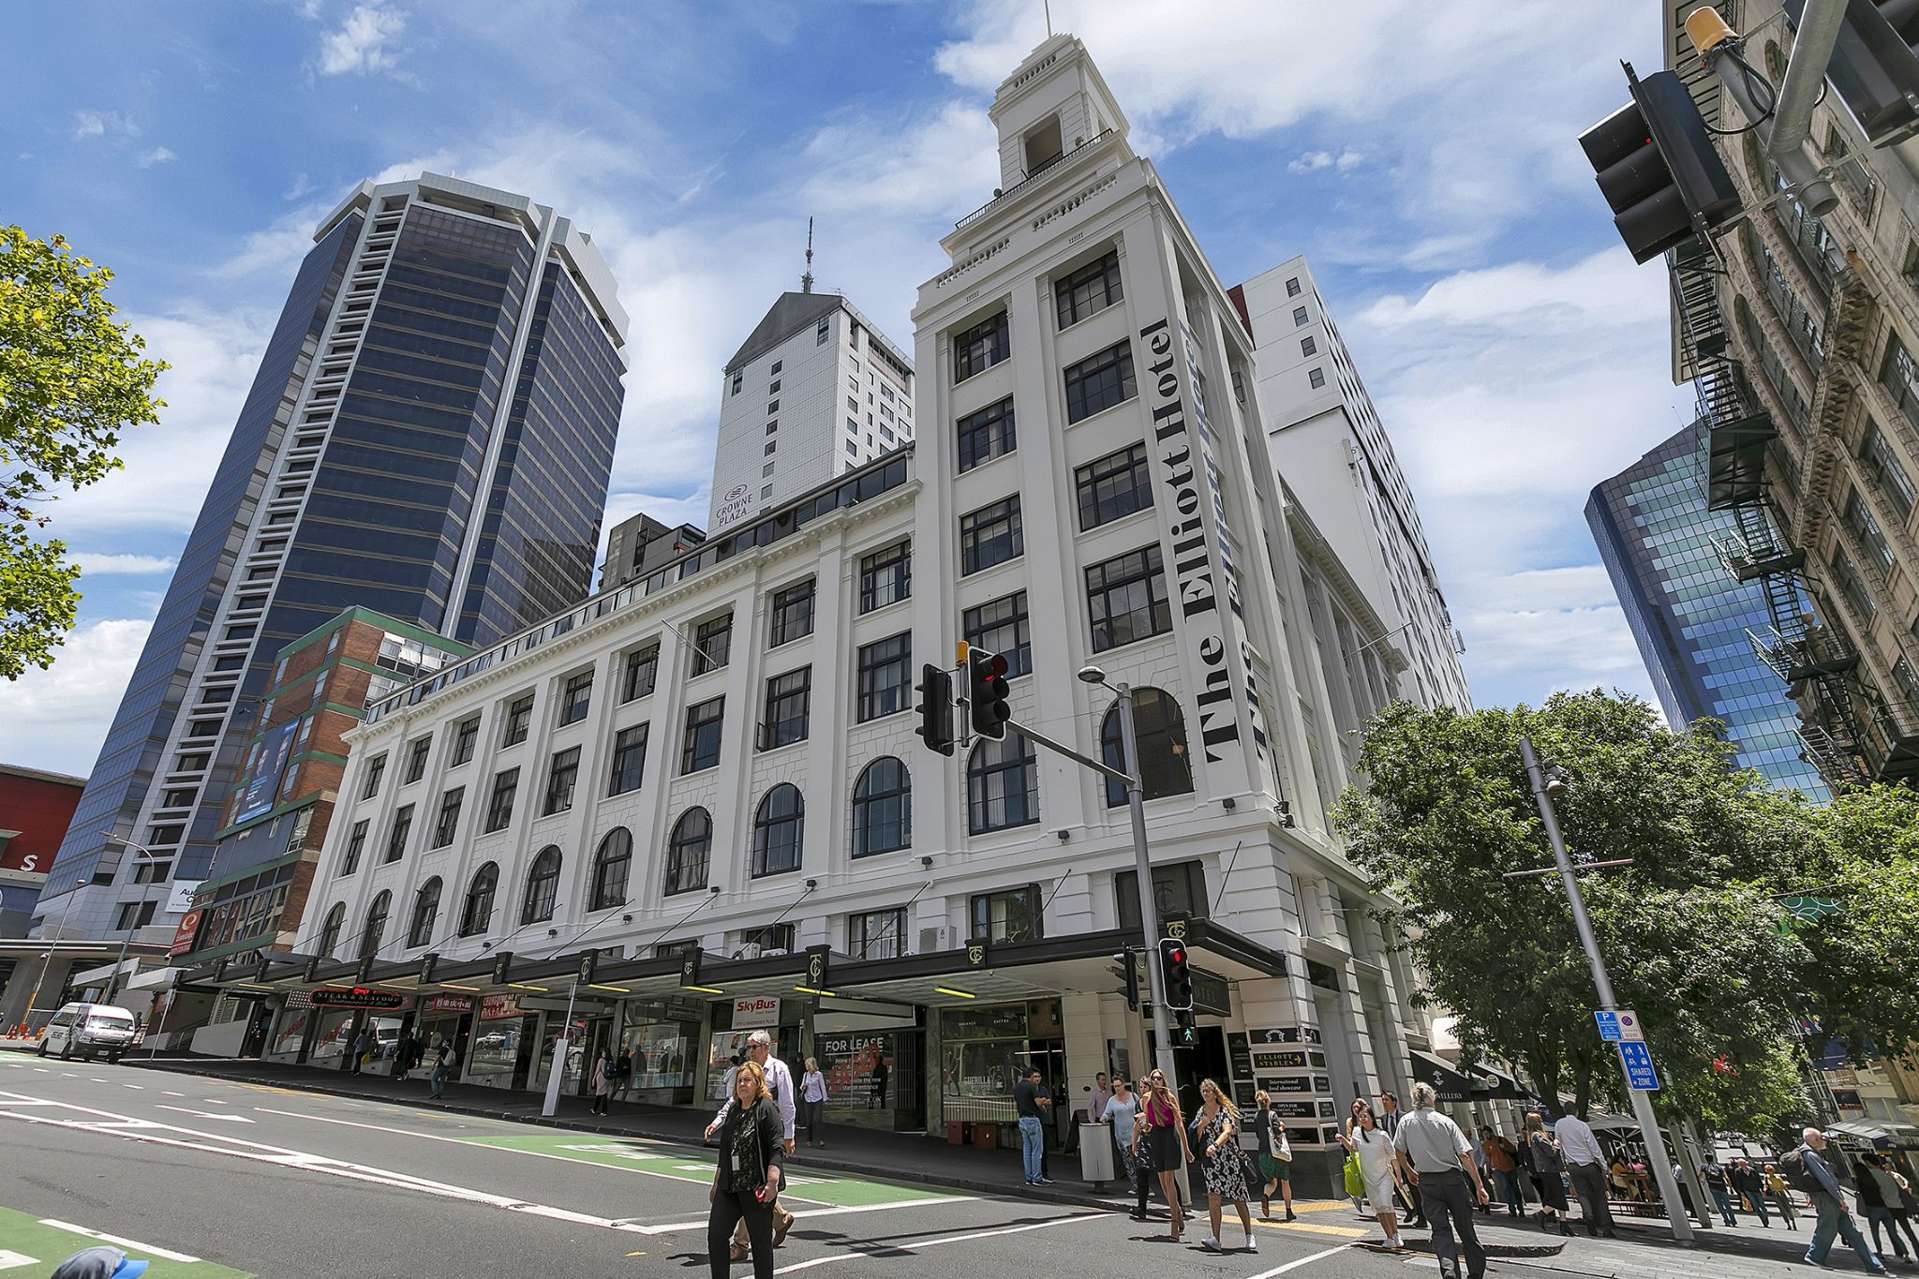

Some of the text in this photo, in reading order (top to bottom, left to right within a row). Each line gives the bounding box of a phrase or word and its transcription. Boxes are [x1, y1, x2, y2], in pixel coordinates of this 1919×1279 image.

[716, 494, 753, 519] CROWNE
[719, 507, 747, 527] PLAZA
[1140, 315, 1242, 763] The Elliott Hotel
[1241, 639, 1269, 762] The
[20, 854, 38, 872] S
[317, 991, 347, 1000] STEAK
[736, 999, 776, 1012] SkyBus
[1602, 1012, 1610, 1021] P
[825, 1036, 884, 1052] FOR LEASE
[1258, 1053, 1293, 1061] ELLIOTT
[1630, 1067, 1652, 1076] SHARED
[1637, 1077, 1652, 1086] ZONE
